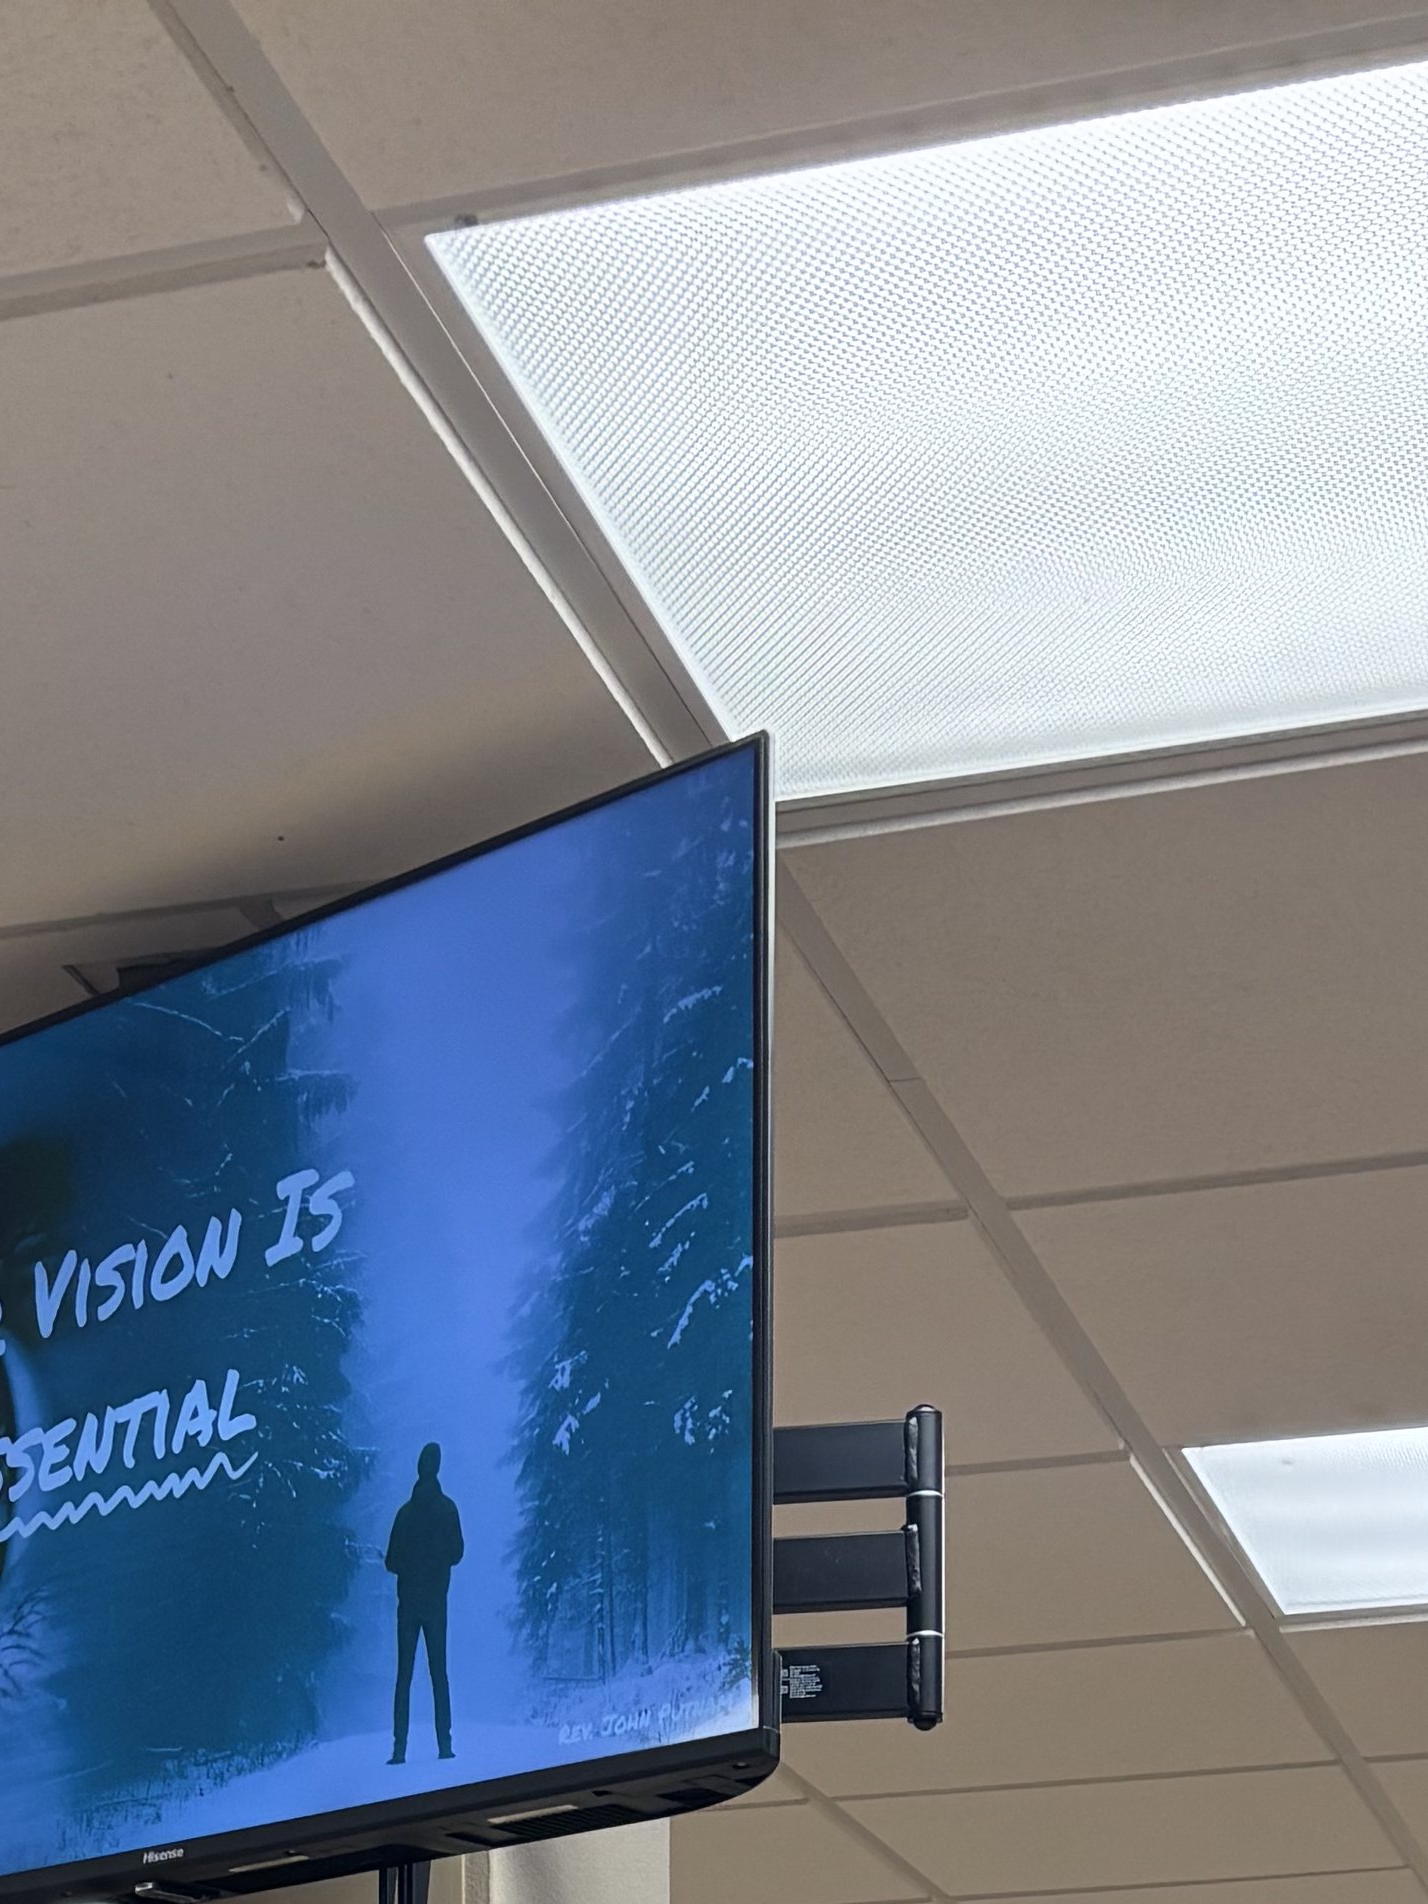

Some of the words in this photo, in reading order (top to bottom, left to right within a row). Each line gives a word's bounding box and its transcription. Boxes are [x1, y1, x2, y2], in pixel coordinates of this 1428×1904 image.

[34, 1208, 242, 1338] VISION
[265, 1168, 356, 1267] IS
[600, 1709, 651, 1737] JOHN
